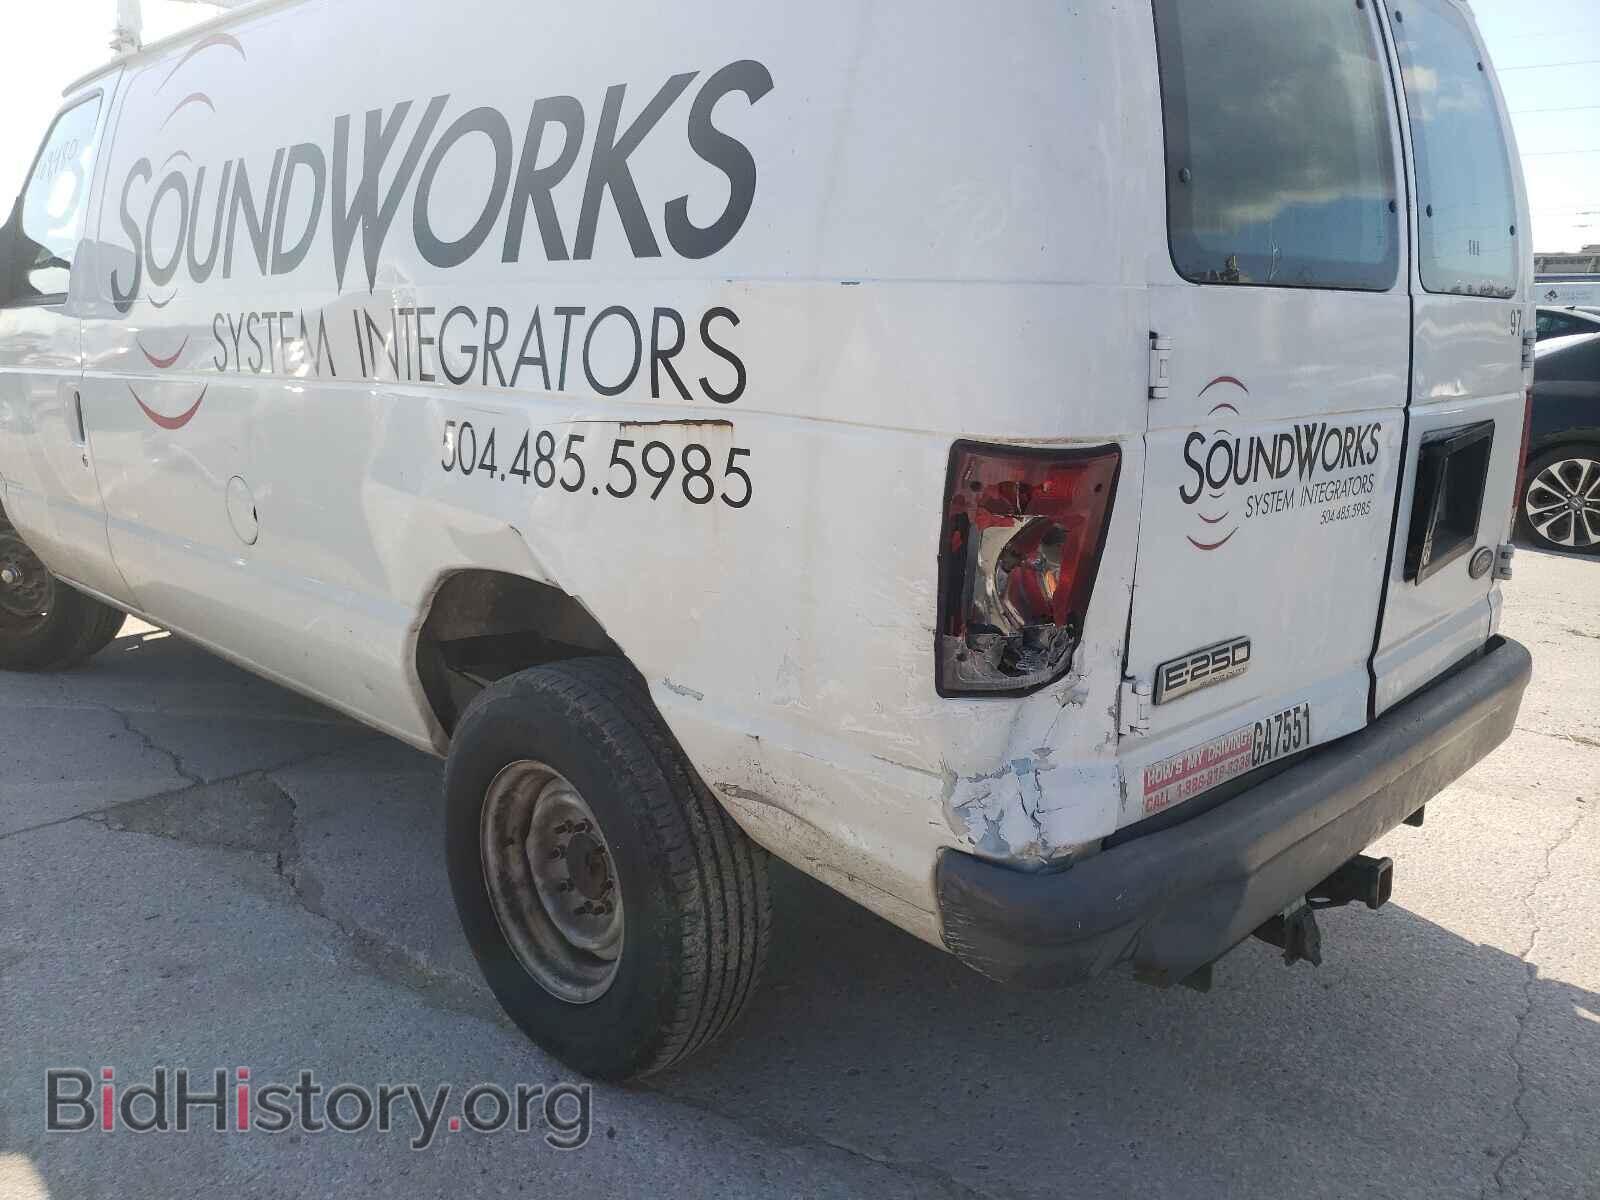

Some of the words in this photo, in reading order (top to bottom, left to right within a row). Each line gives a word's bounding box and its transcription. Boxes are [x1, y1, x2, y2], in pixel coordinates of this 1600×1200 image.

[1510, 309, 1522, 337] 97
[213, 307, 336, 376] SYSTEM
[353, 305, 747, 403] INTEGRATORS
[441, 420, 752, 508] 504.485.5985
[1245, 487, 1295, 518] SYSTEM
[1300, 473, 1374, 507] INTEGRATORS
[1320, 500, 1371, 525] 504.485.5985
[1184, 748, 1204, 772] MY
[1145, 789, 1169, 812] CALL
